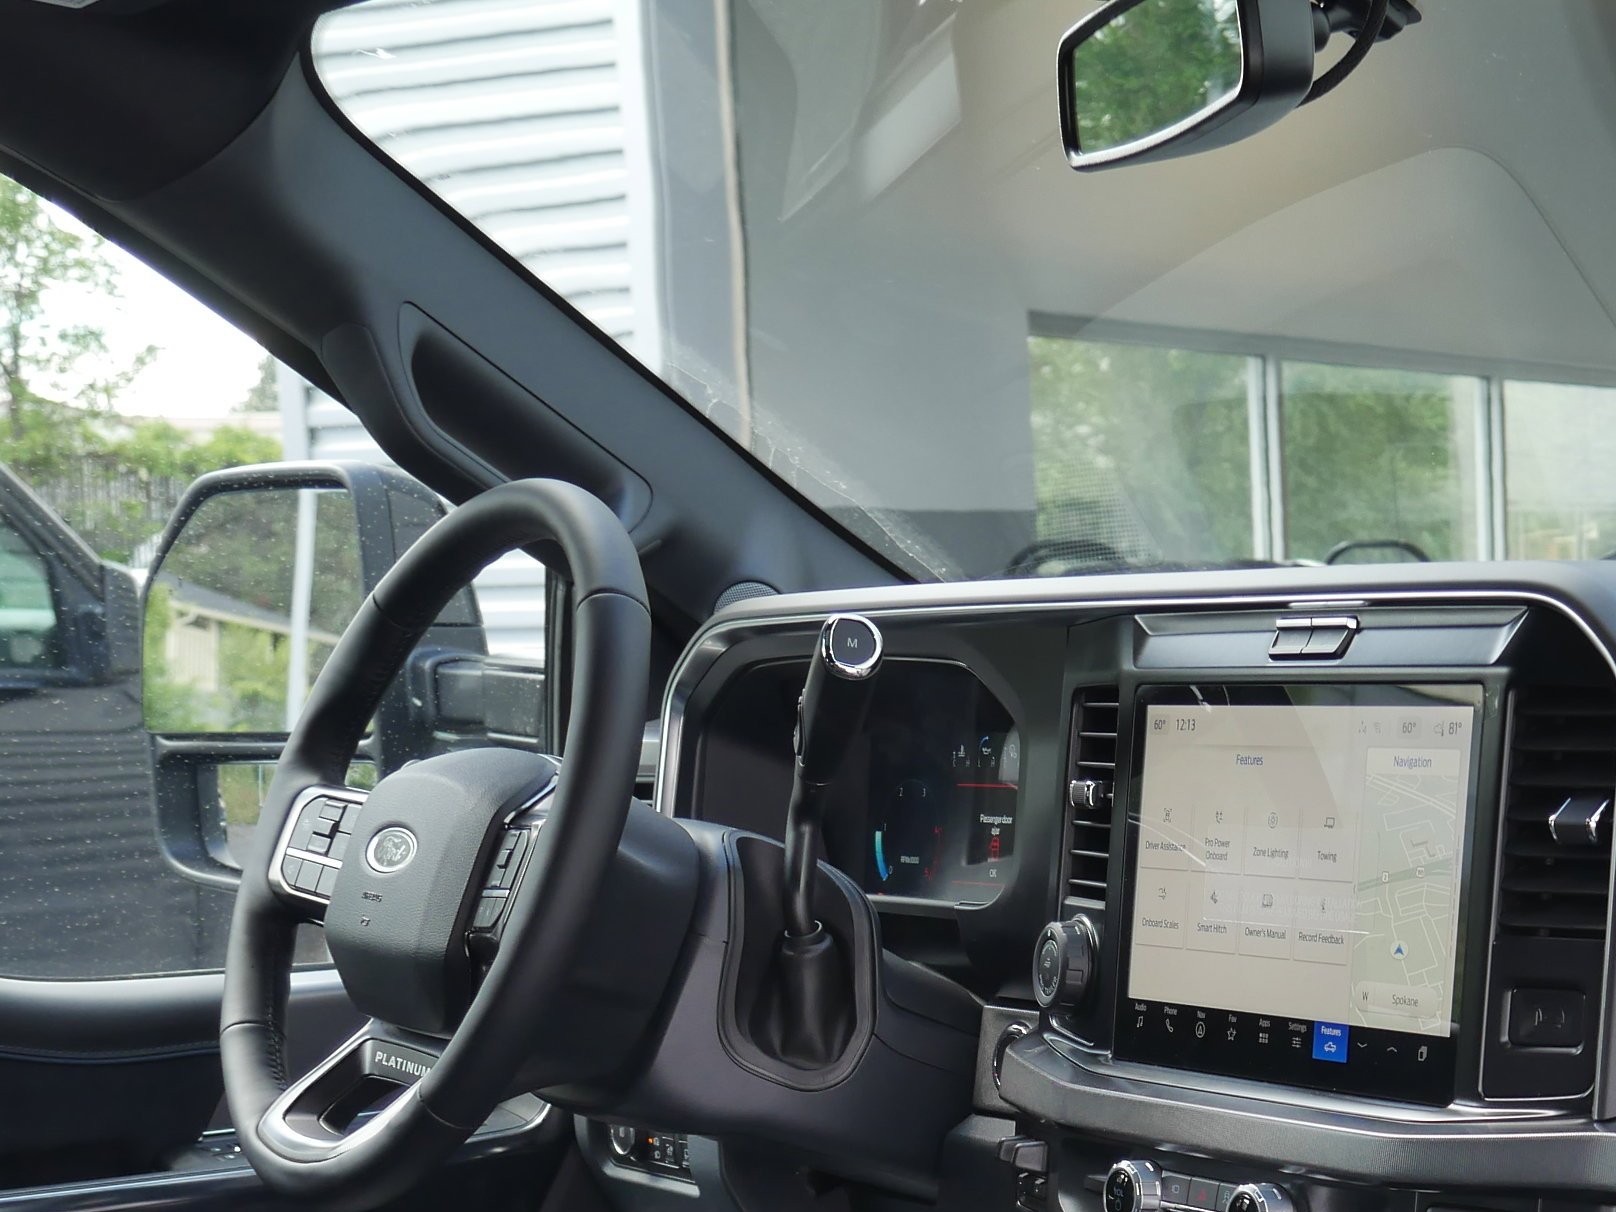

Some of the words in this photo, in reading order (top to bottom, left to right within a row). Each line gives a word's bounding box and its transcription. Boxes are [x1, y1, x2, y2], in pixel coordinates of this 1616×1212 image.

[847, 637, 858, 648] M
[1175, 718, 1196, 731] 12:13
[1235, 753, 1264, 766] Features
[1393, 755, 1432, 769] Navigation
[1145, 840, 1160, 850] Driver
[1204, 837, 1214, 847] Pro
[1214, 838, 1231, 848] Power
[1205, 851, 1228, 861] Onboard
[1253, 847, 1266, 857] Zone
[1267, 848, 1289, 859] Lighting
[1317, 850, 1337, 862] Towing
[1197, 922, 1211, 933] Smart
[1211, 924, 1227, 935] Hitch
[1244, 927, 1266, 938] Owner's
[1266, 929, 1287, 940] Manual
[1298, 932, 1317, 943] Record
[1317, 933, 1344, 945] Feedback
[1362, 991, 1369, 1001] W
[1391, 994, 1419, 1007] Spokane
[1134, 1002, 1147, 1012] Audio
[1163, 1006, 1178, 1016] Phone
[1259, 1018, 1271, 1028] Apps
[1288, 1022, 1307, 1033] Settings
[1320, 1026, 1342, 1037] Features
[374, 1050, 432, 1077] PLATINUM
